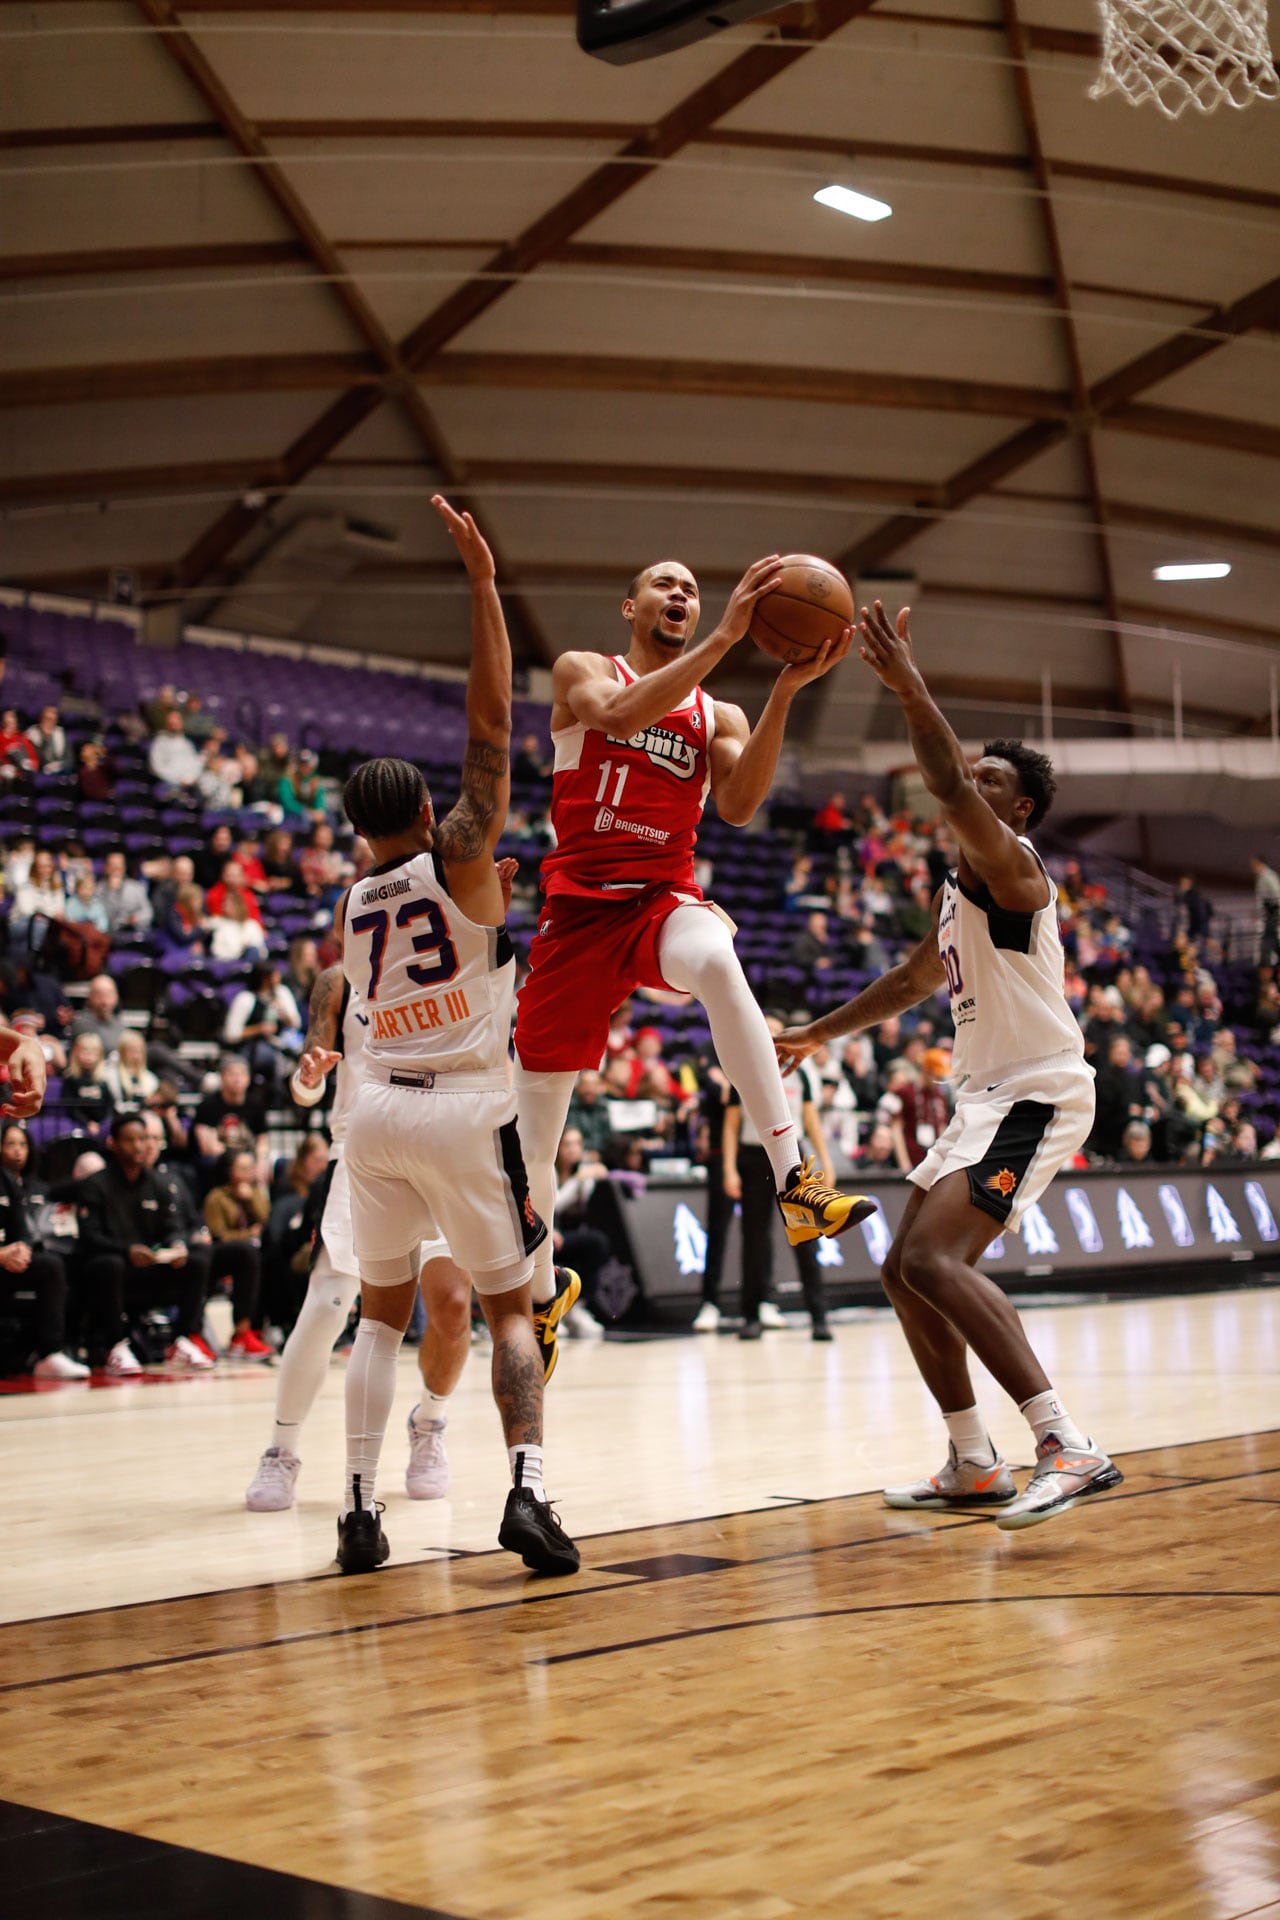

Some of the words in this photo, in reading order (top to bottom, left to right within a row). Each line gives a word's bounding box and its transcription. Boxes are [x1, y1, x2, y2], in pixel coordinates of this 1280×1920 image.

[650, 726, 674, 739] CITY
[606, 731, 700, 779] emix
[595, 760, 630, 807] 11
[615, 819, 671, 841] BRIGHTSIDE
[351, 898, 461, 1001] 73
[444, 989, 471, 1023] III
